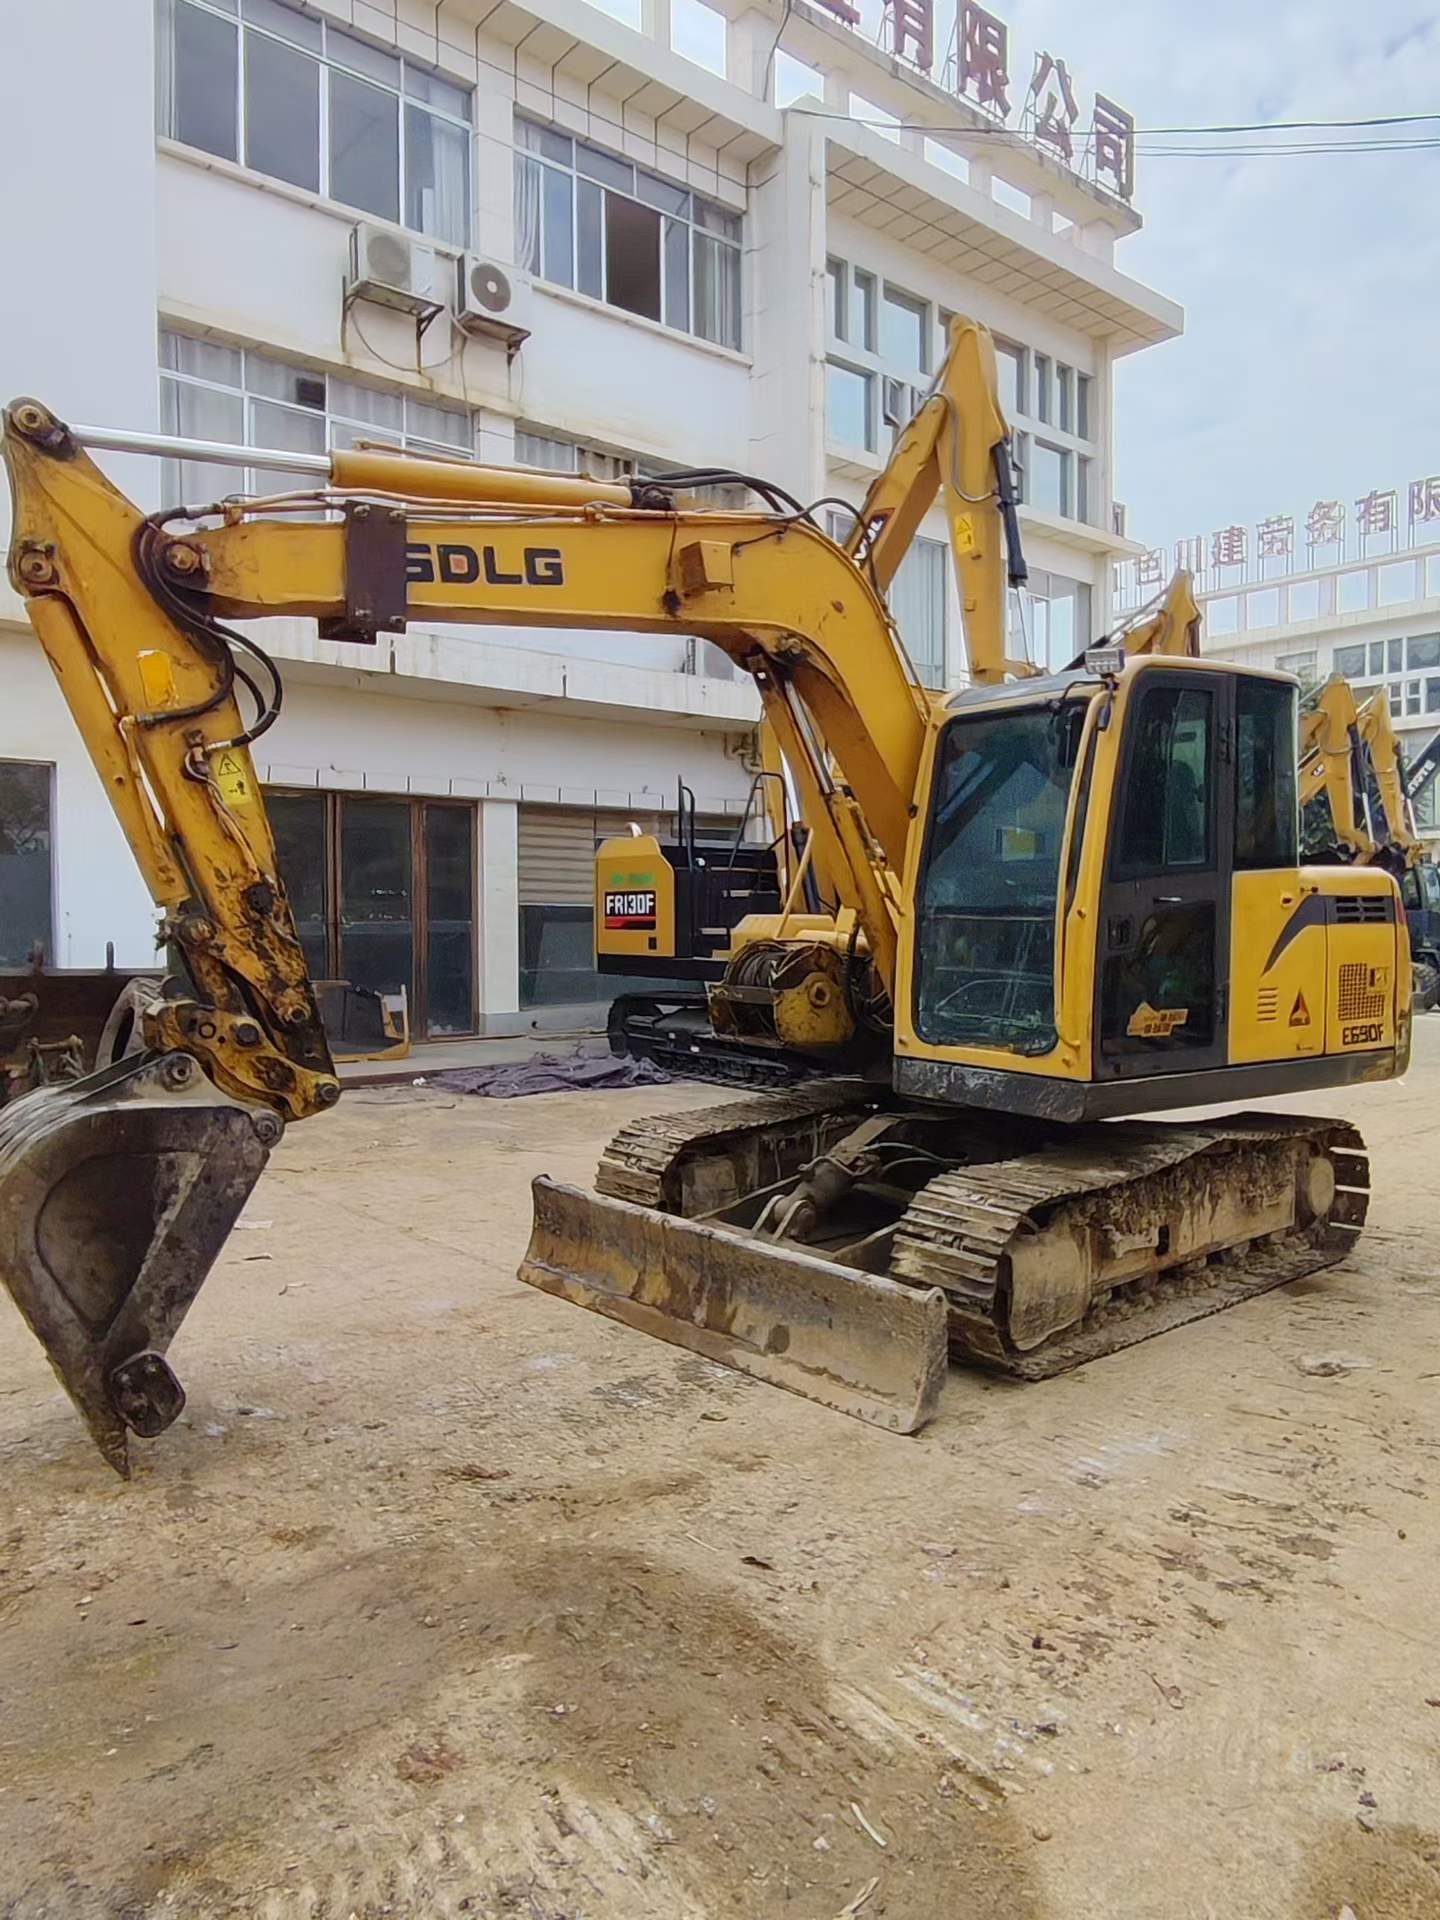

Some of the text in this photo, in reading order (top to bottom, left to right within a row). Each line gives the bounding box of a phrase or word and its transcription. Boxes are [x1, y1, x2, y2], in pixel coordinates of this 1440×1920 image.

[803, 0, 1135, 199] 有限公司
[406, 543, 564, 586] SDLG
[606, 894, 655, 915] FR130F
